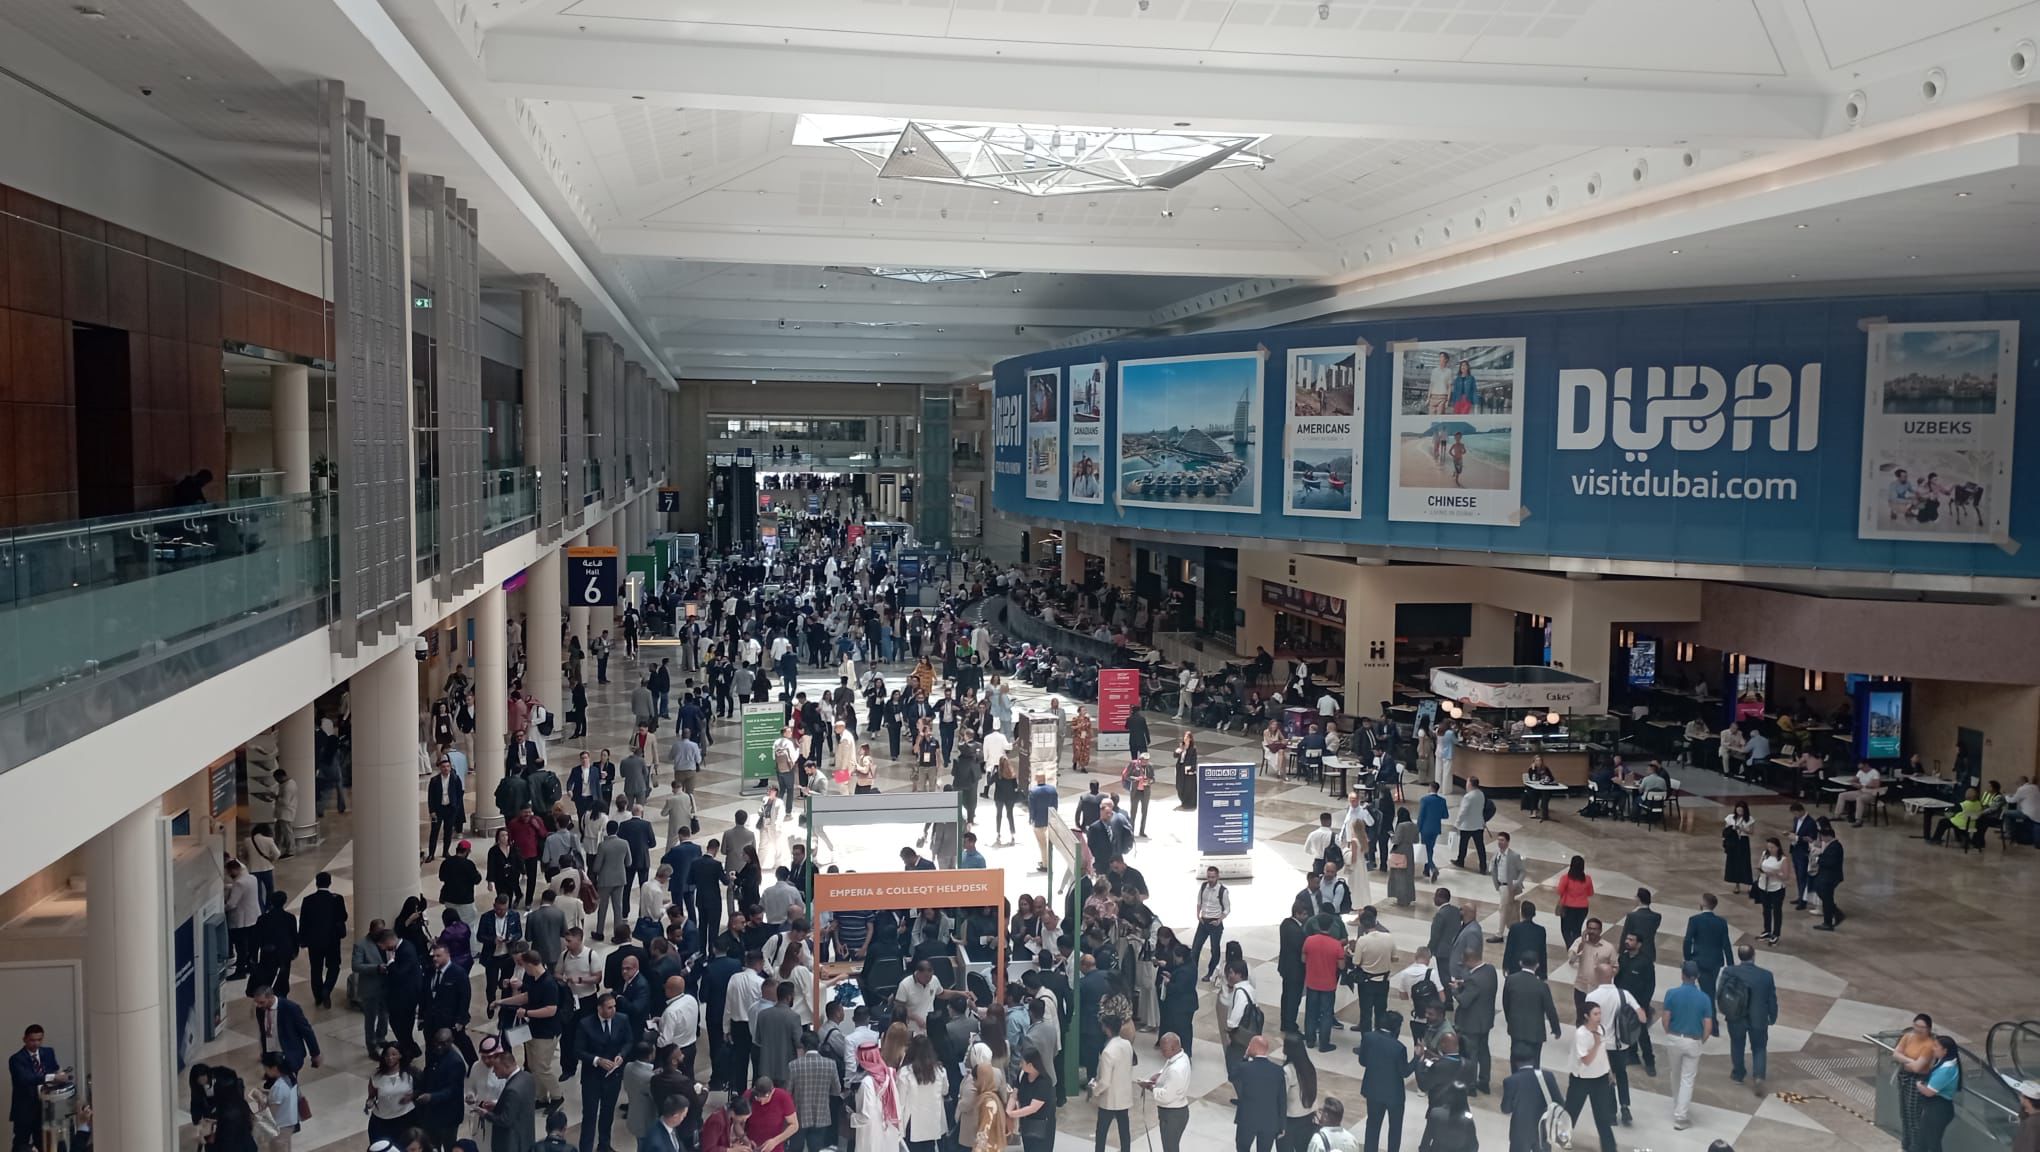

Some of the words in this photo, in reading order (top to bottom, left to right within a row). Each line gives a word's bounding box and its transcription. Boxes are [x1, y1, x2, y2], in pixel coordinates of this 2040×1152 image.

[1556, 363, 1822, 462] DUBAI
[1296, 423, 1351, 435] AMERICANS
[1904, 421, 1972, 434] UZBEKS
[1571, 469, 1798, 500] visitdubai.com
[665, 500, 673, 512] 7
[1427, 495, 1477, 508] CHINESE
[584, 577, 602, 604] 6
[1546, 692, 1571, 701] Cakes
[829, 889, 874, 898] EMPERIA
[876, 888, 884, 896] &
[886, 886, 933, 896] COLLEQT
[936, 883, 988, 893] HELPDESK
